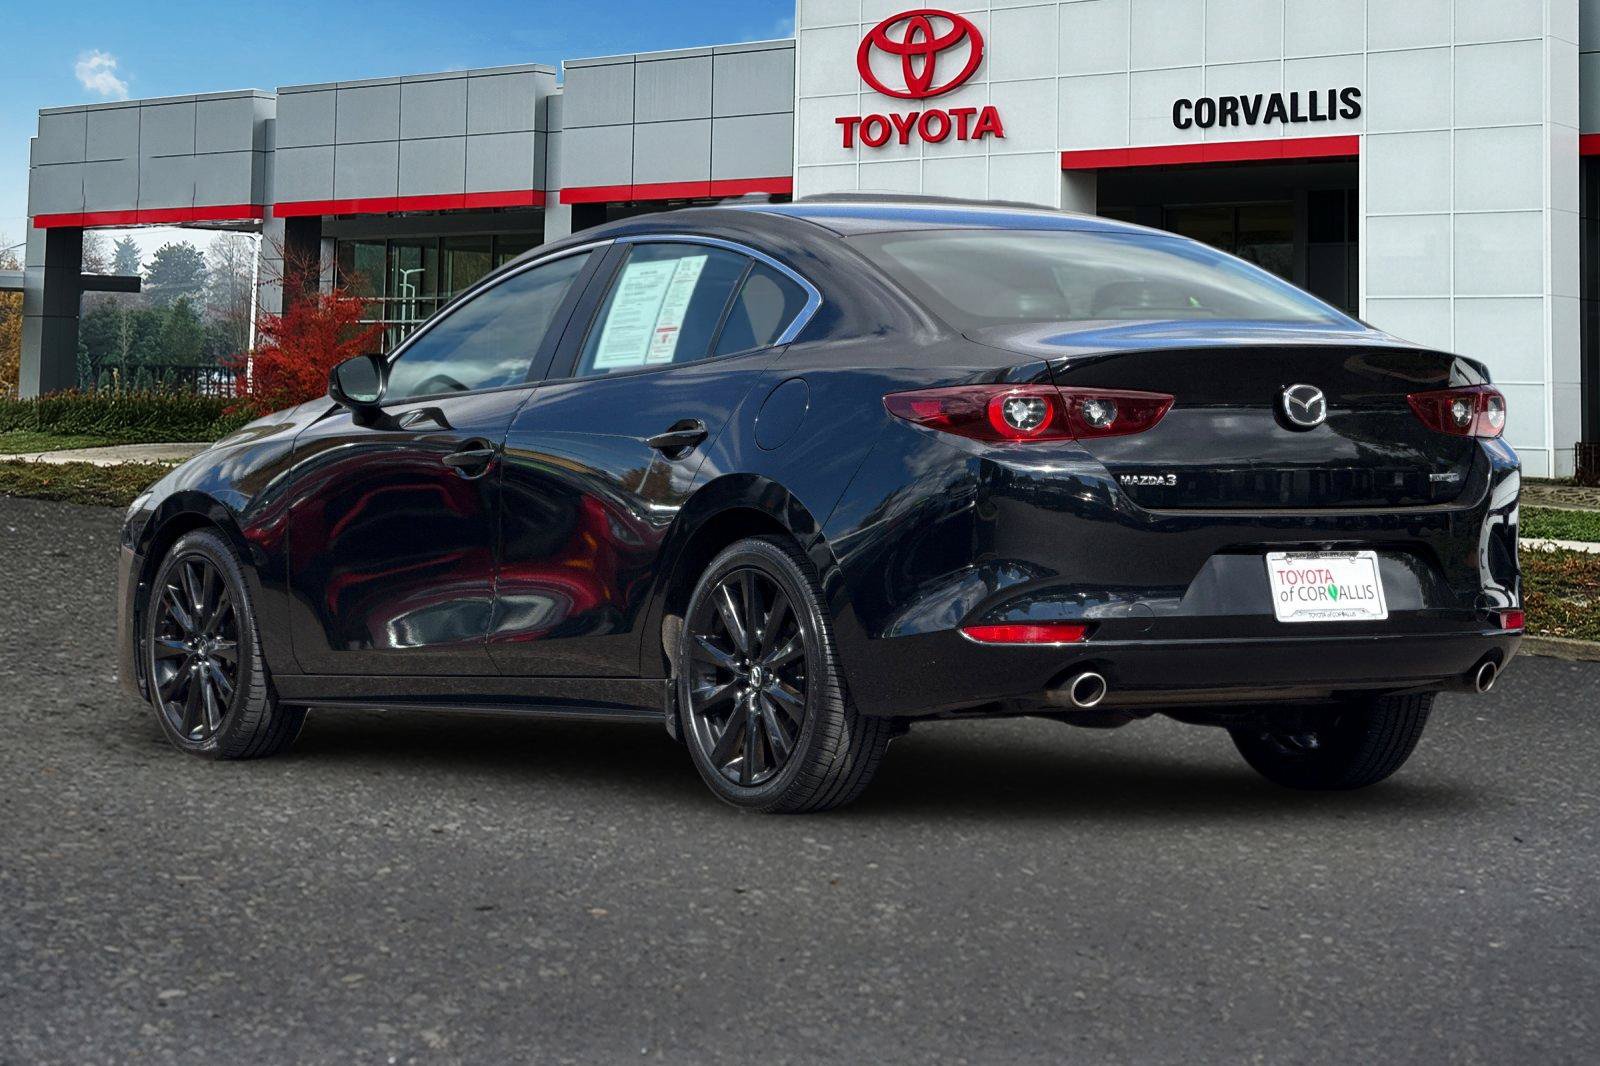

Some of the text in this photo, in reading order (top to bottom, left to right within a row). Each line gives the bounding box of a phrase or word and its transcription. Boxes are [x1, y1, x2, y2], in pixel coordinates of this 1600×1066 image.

[1172, 87, 1362, 130] CORVALLIS
[835, 105, 1005, 149] TOYOTA
[1277, 569, 1335, 585] TOYOTA
[1280, 586, 1294, 602] of
